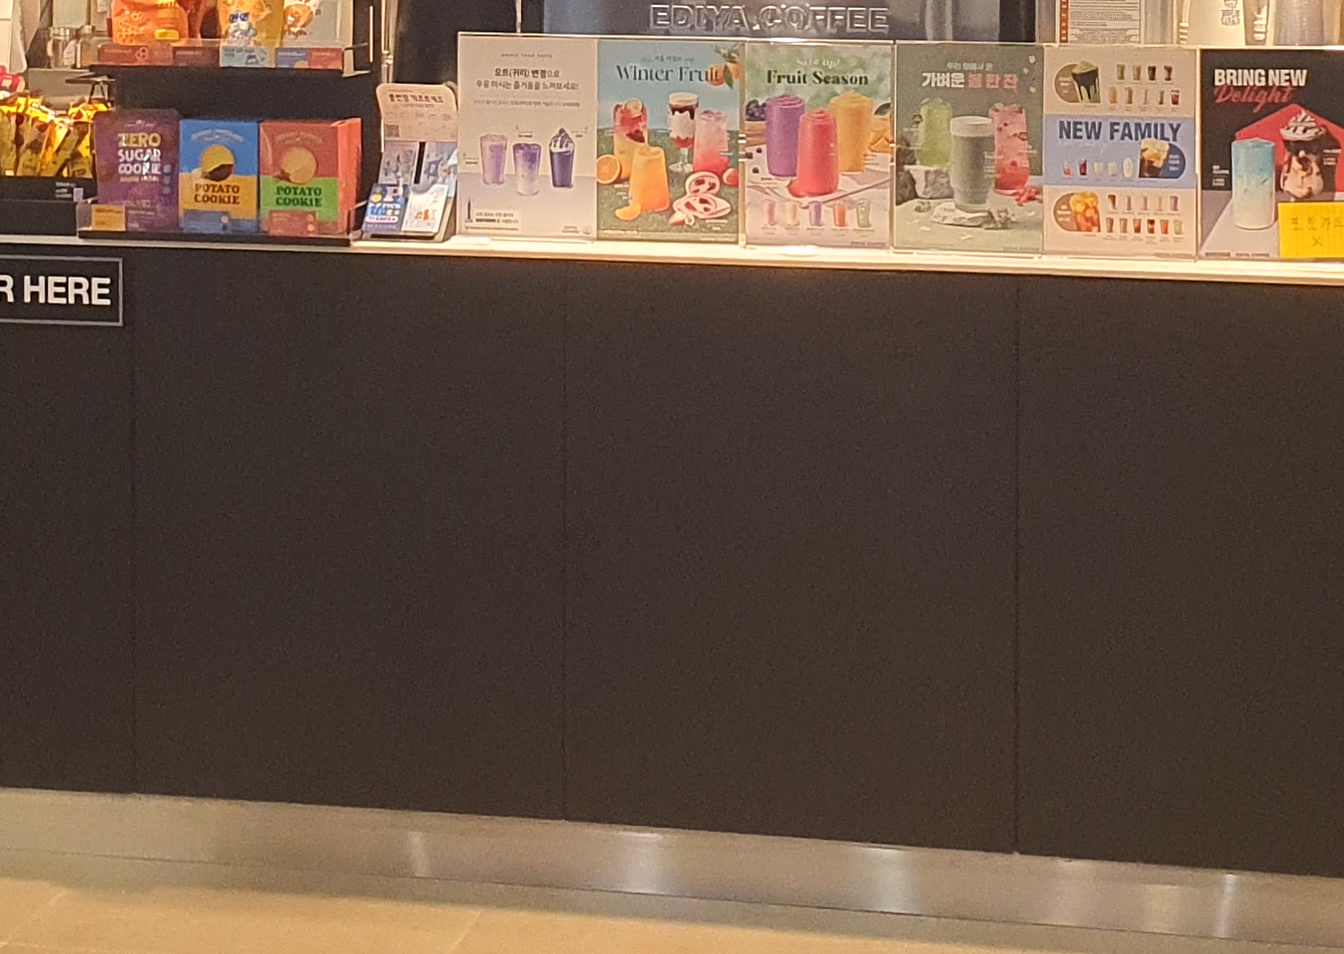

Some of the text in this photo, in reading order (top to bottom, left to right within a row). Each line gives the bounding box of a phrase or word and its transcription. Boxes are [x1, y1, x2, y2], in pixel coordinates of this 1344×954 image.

[649, 4, 890, 33] EDIYA COFFEE
[615, 64, 721, 83] Winter Fruit
[766, 69, 869, 86] Fruit Season
[921, 72, 965, 88] 가벼운
[1214, 69, 1308, 87] BRING NEW
[1214, 85, 1297, 113] Delight
[1058, 120, 1182, 142] NEW FAMILY
[117, 132, 161, 148] ZERO
[117, 148, 161, 163] SUGAR
[117, 162, 162, 176] COOKIE
[194, 183, 241, 194] POTATO
[275, 185, 323, 197] POTATO
[193, 194, 241, 205] COOKIE
[275, 196, 323, 208] COOKIE
[23, 275, 112, 306] HERE
